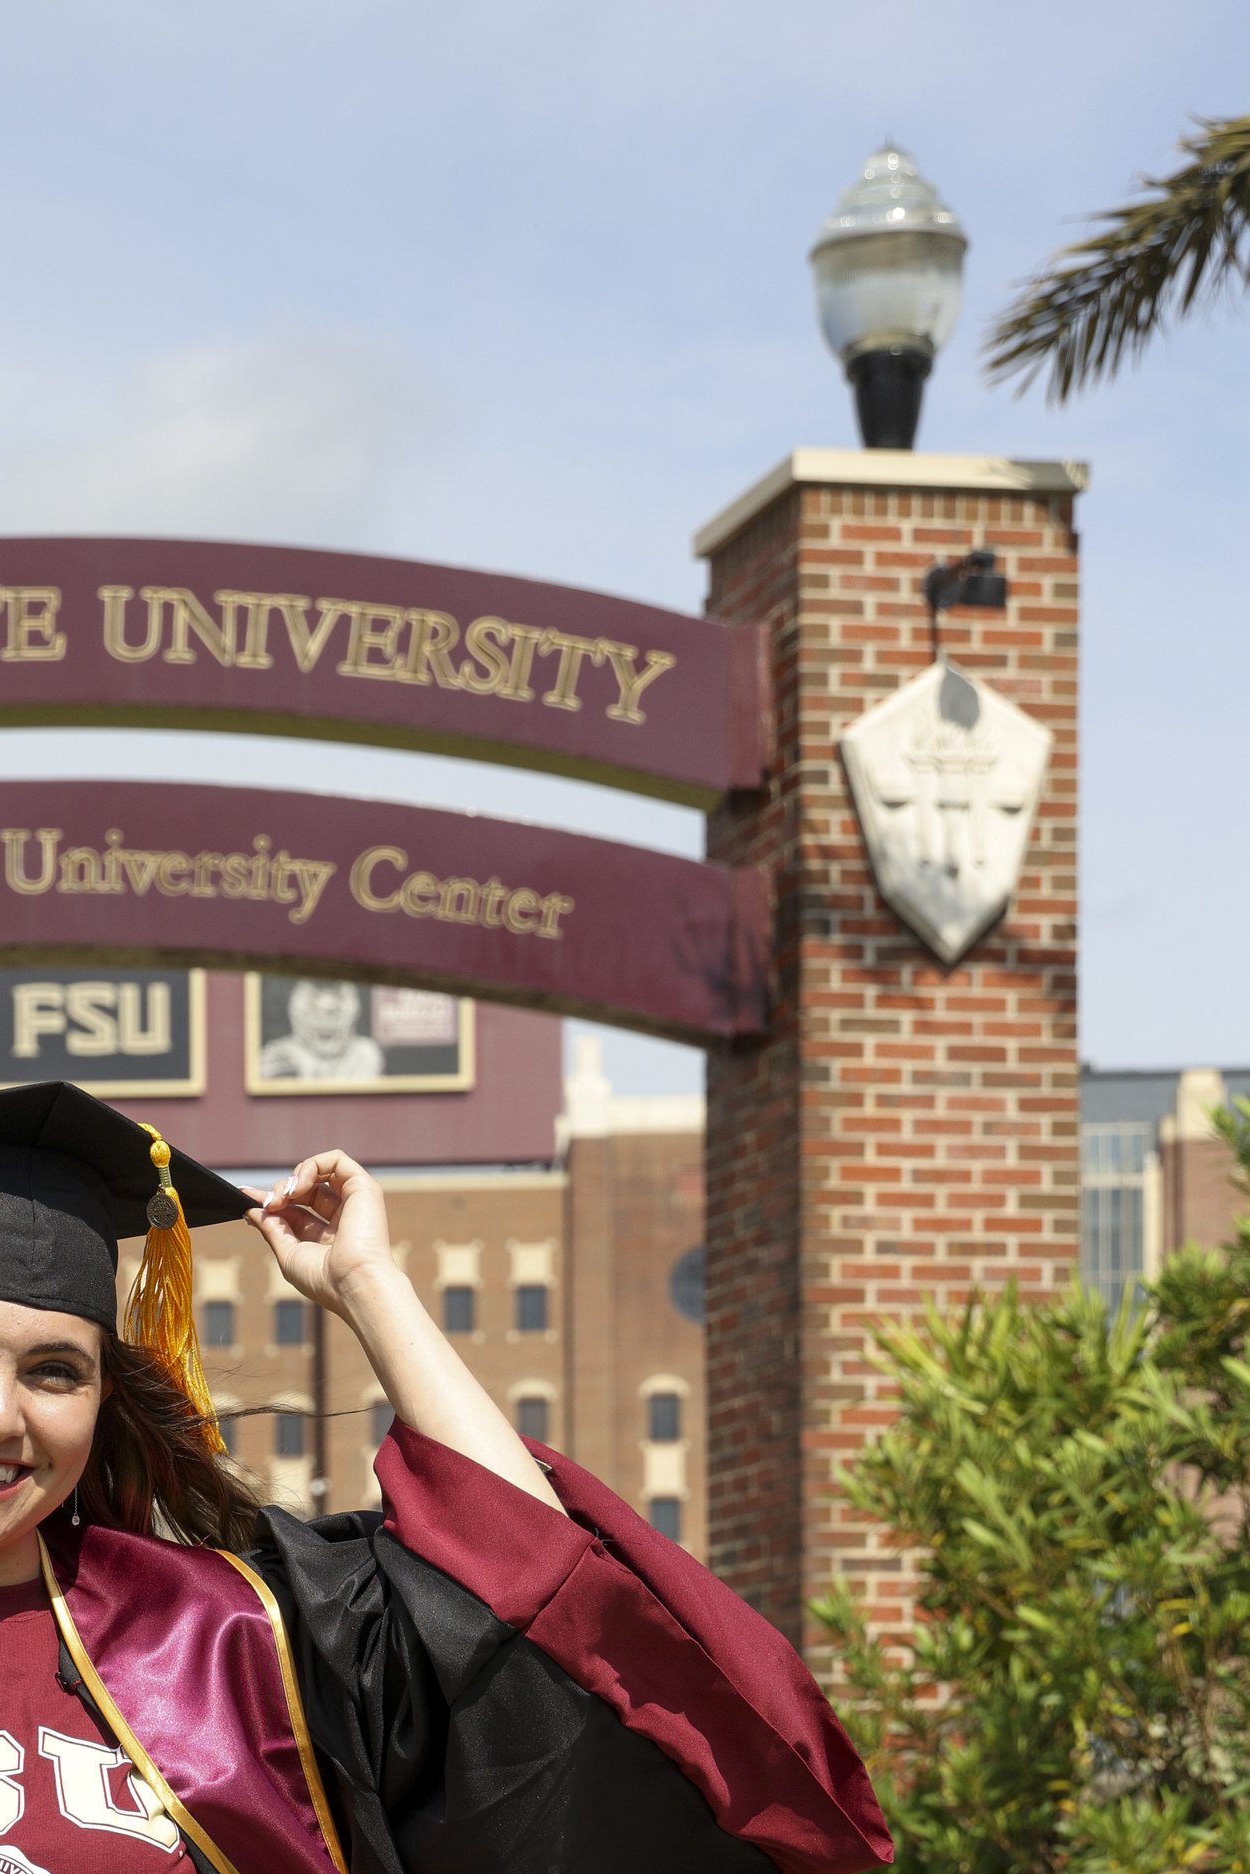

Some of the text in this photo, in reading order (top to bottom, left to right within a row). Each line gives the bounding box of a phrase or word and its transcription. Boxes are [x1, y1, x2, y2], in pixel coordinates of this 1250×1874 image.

[97, 585, 676, 725] UNIVERSITY
[0, 827, 337, 925] University
[350, 845, 575, 939] Center
[11, 981, 173, 1058] FSU
